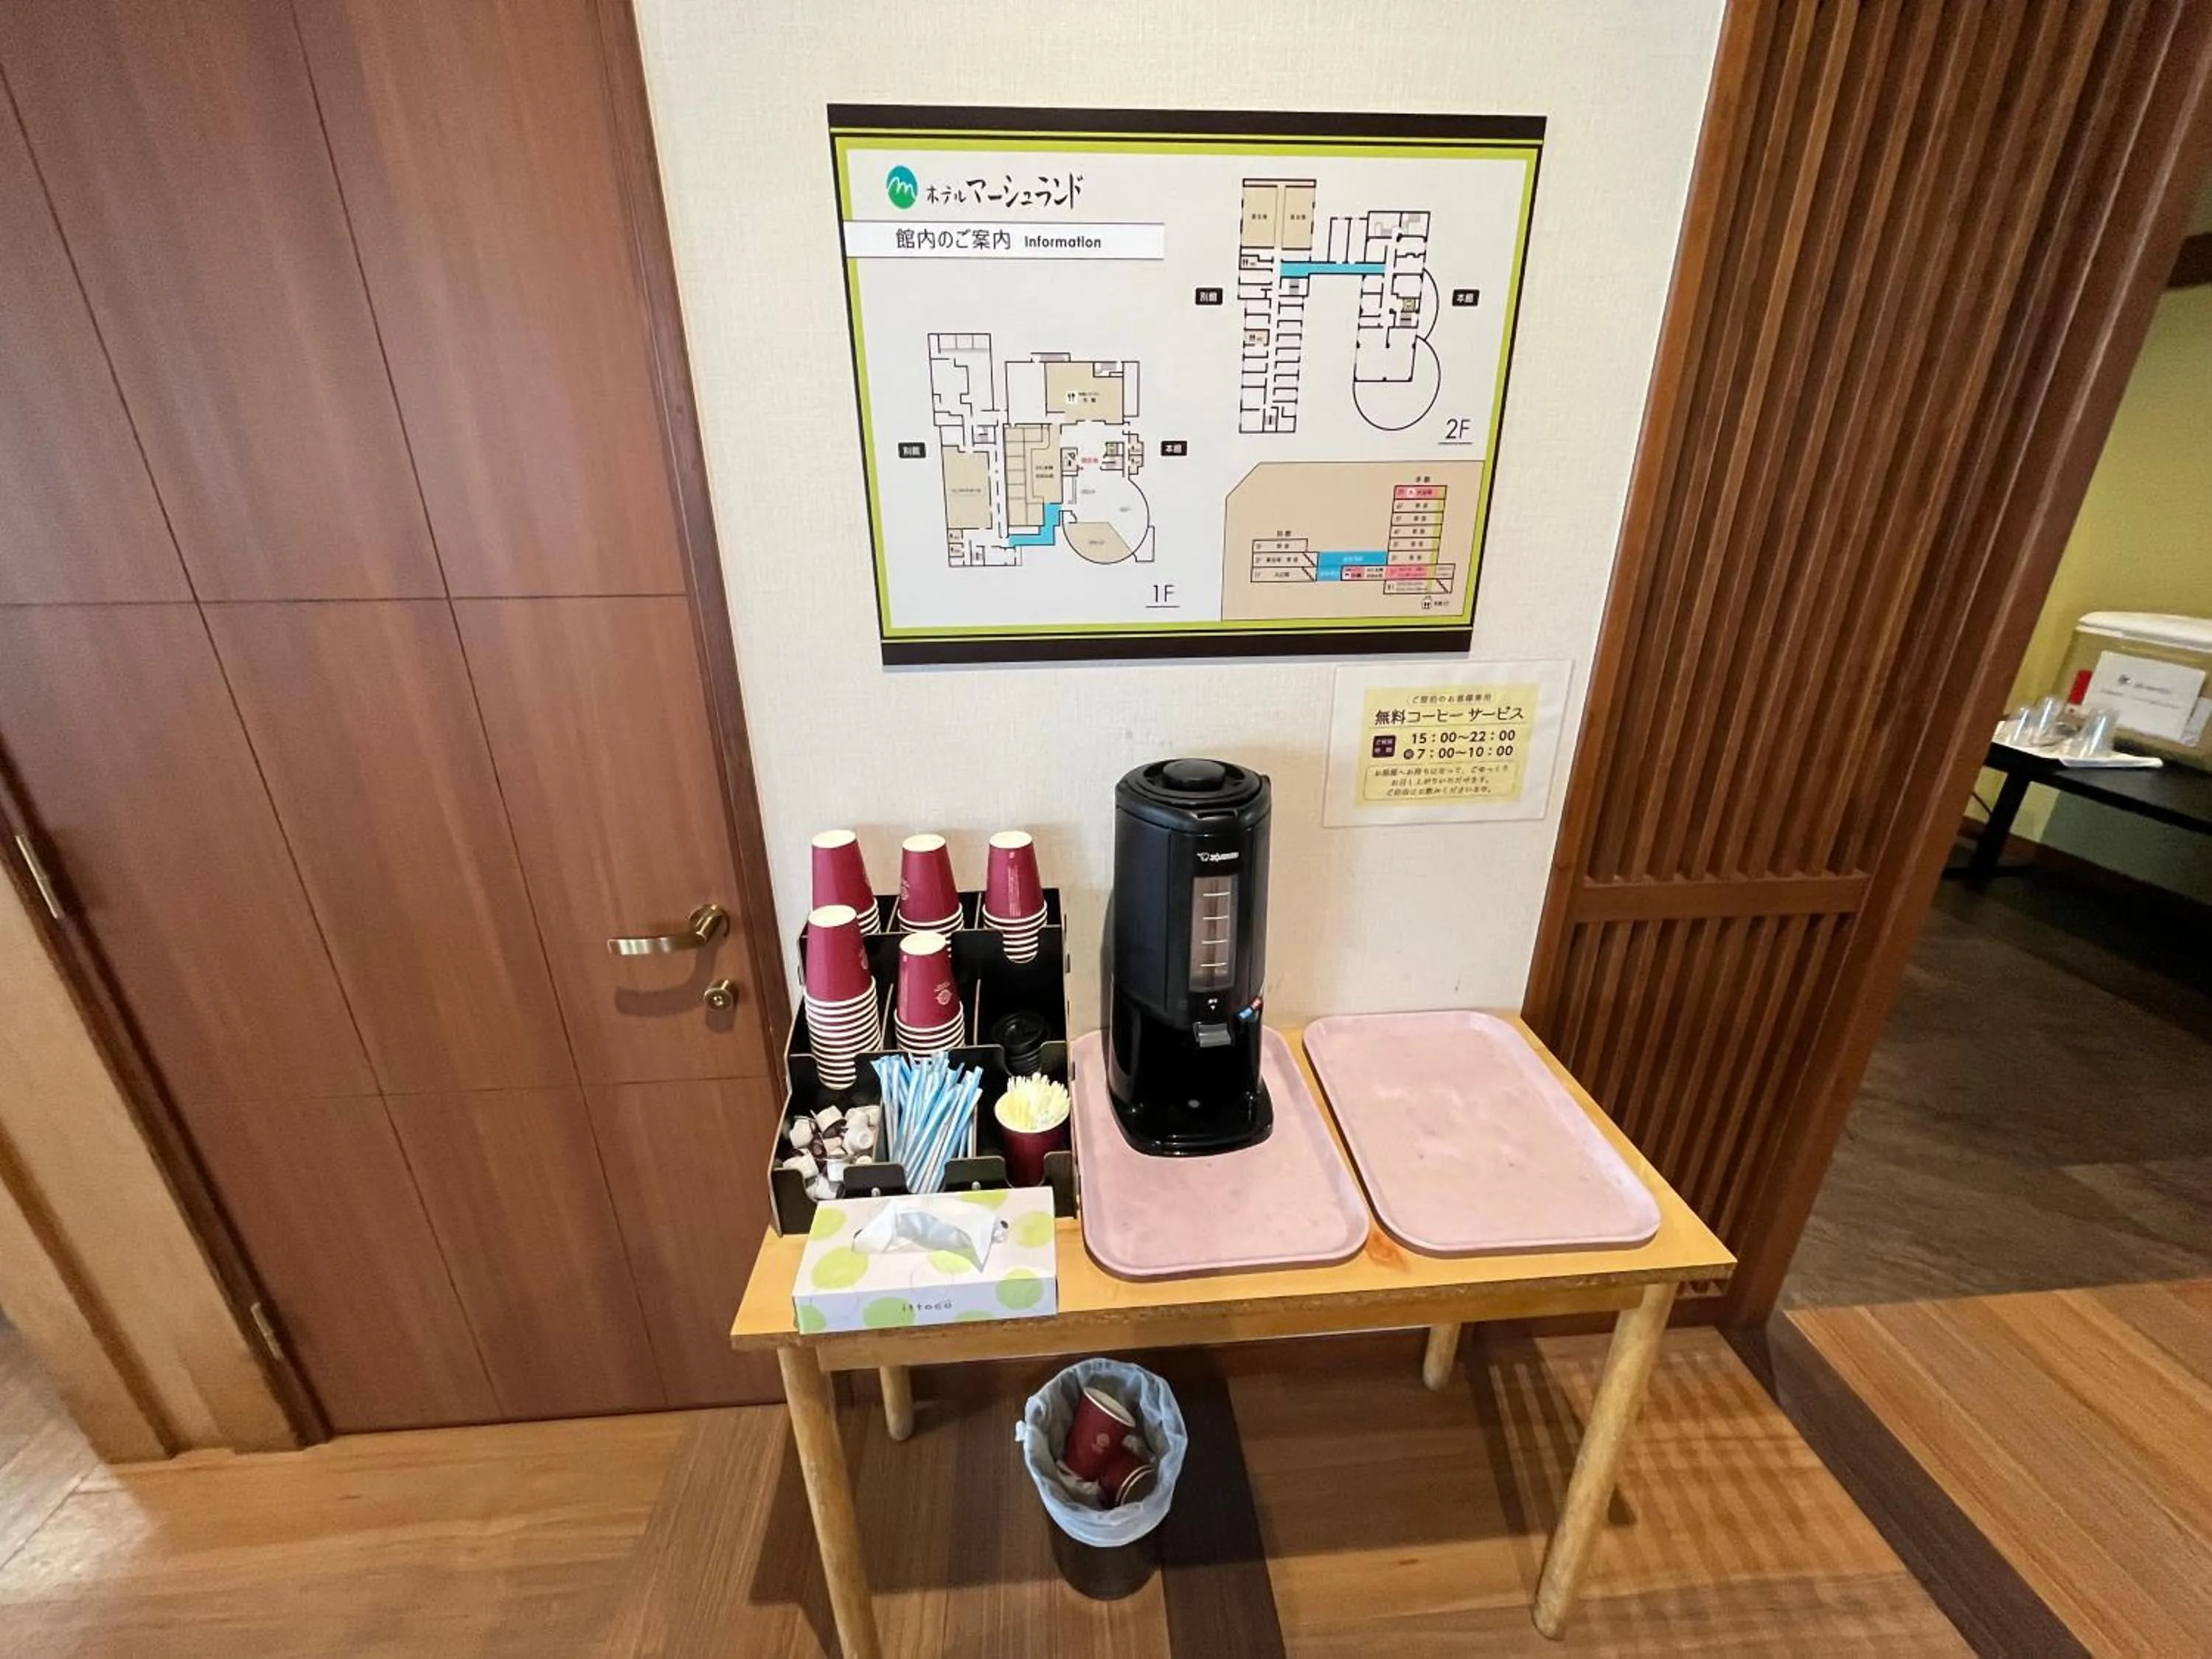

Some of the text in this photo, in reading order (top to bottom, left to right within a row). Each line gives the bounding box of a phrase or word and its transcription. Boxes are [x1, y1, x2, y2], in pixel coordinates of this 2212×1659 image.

[896, 229, 1102, 250] 館内のご案内 Information
[1445, 417, 1471, 440] 2F
[1152, 584, 1175, 602] 1F
